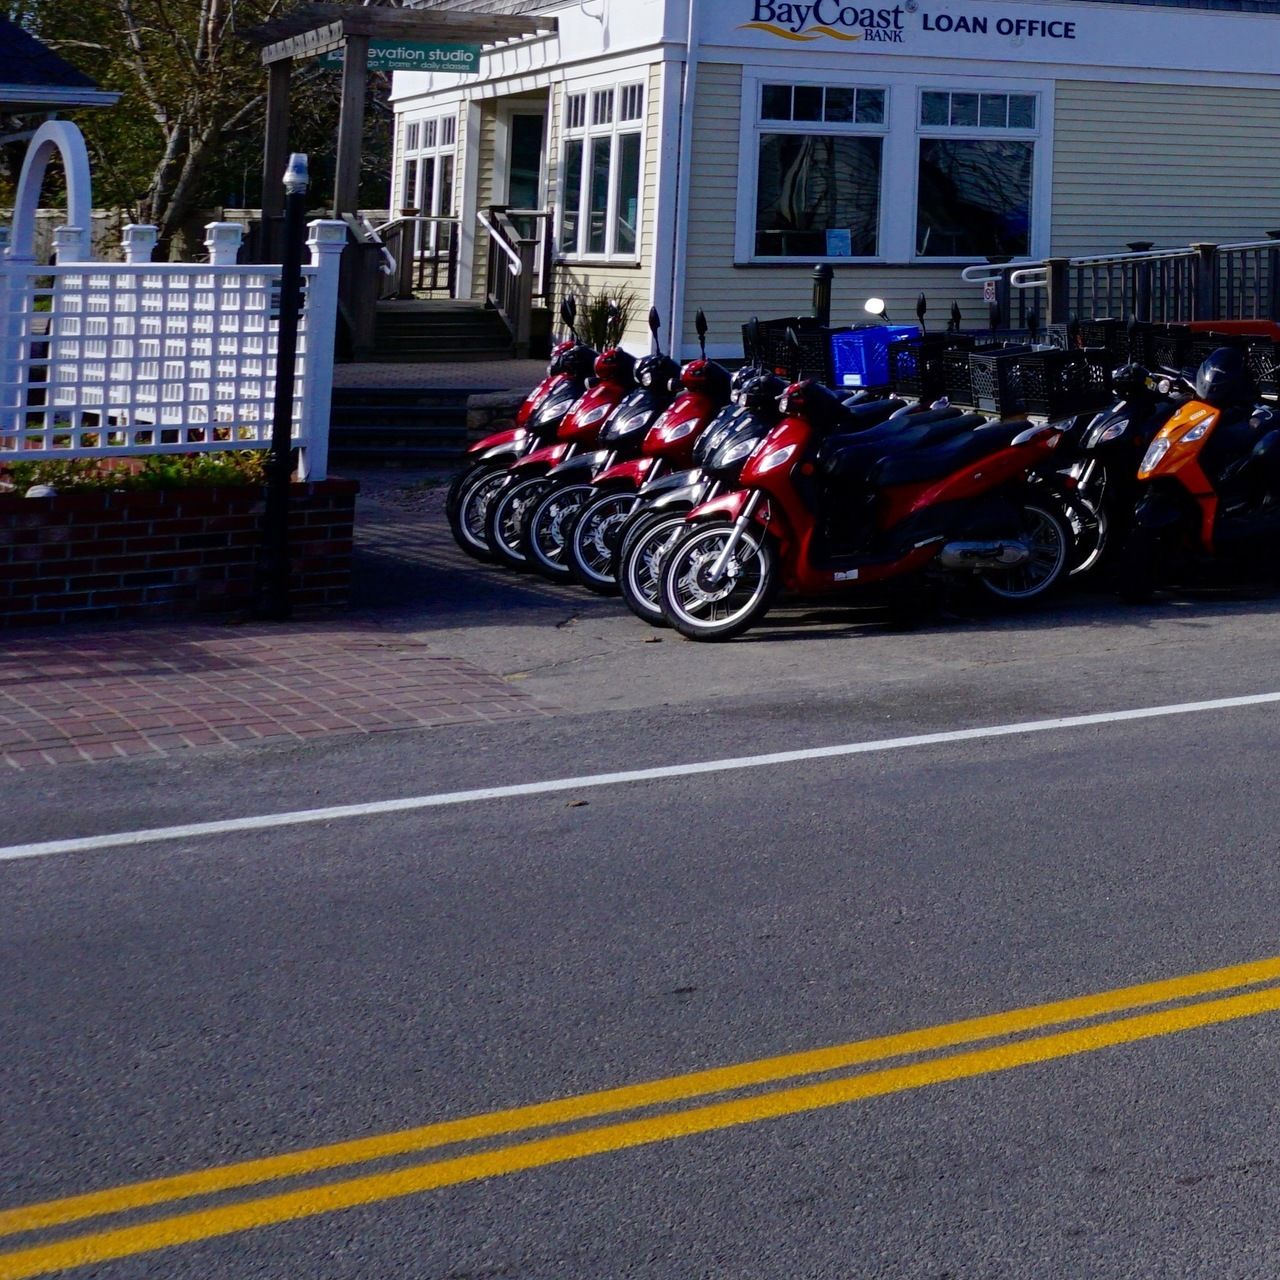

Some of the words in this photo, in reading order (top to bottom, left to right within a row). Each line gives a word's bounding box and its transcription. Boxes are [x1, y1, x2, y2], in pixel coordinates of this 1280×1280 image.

[922, 13, 987, 33] LOAN
[996, 18, 1077, 39] OFFICE
[864, 28, 904, 44] BANK
[429, 49, 474, 62] studio
[421, 61, 440, 71] daily
[441, 63, 470, 71] classes
